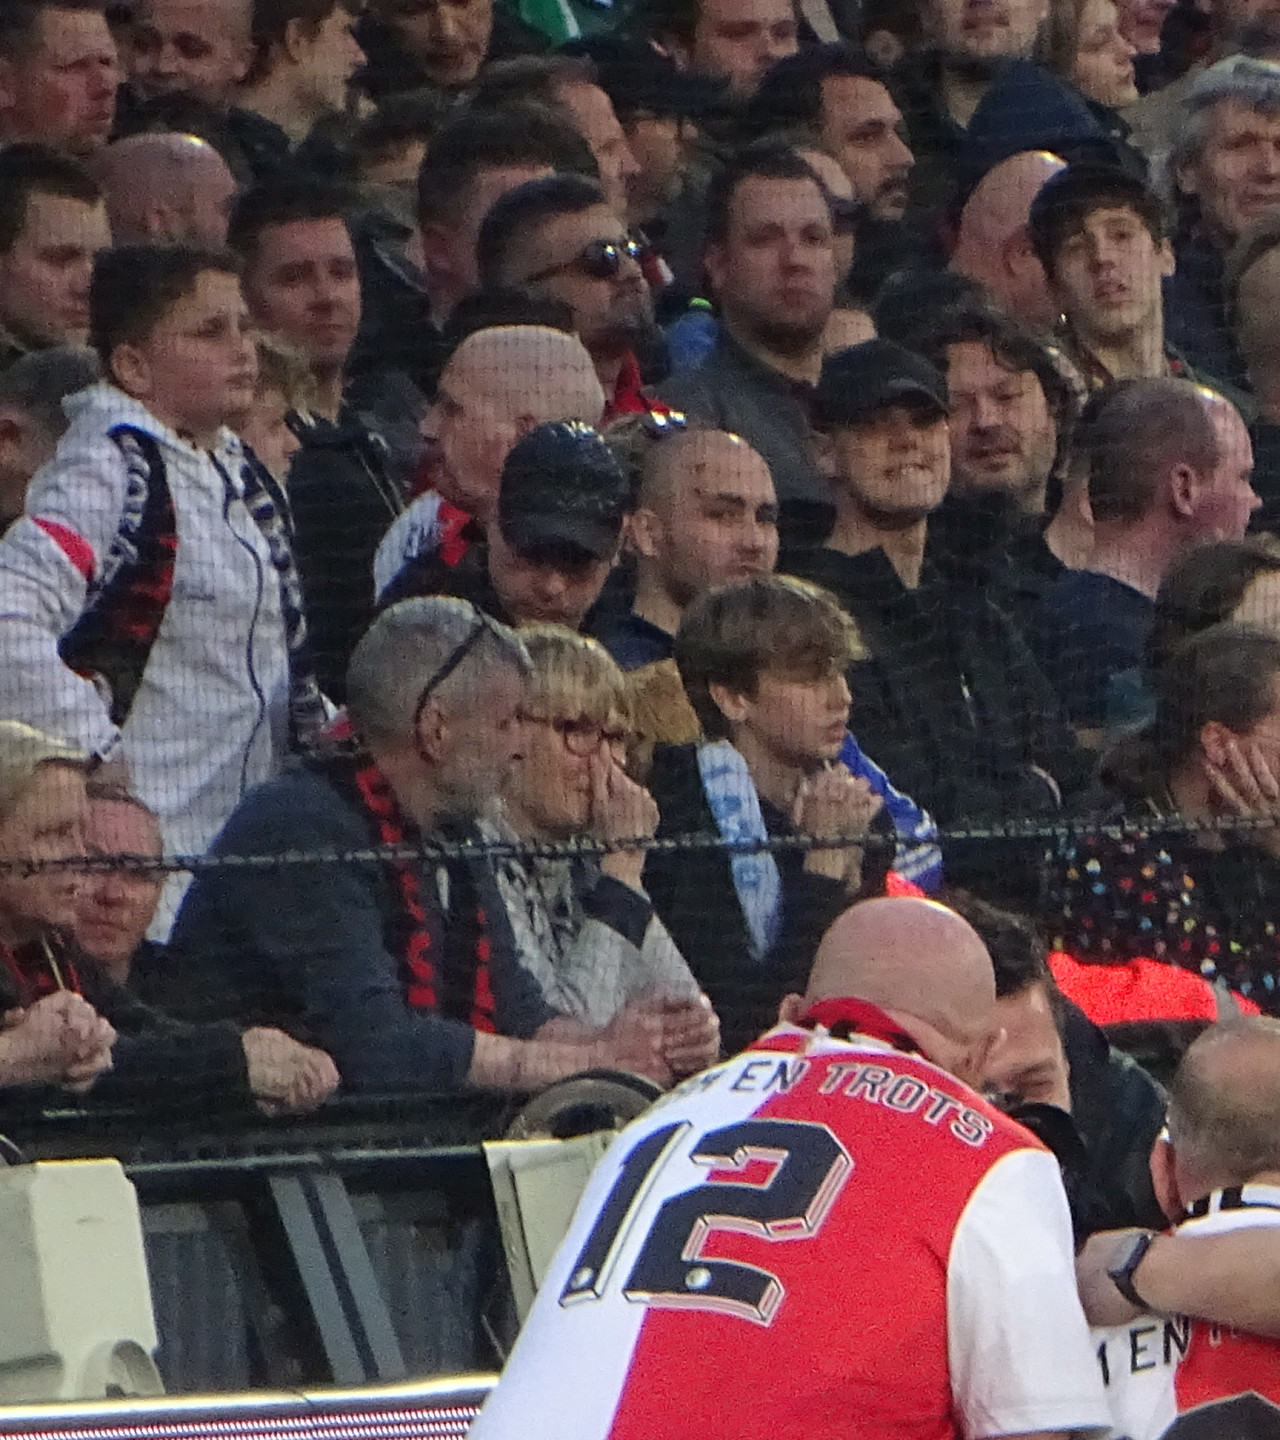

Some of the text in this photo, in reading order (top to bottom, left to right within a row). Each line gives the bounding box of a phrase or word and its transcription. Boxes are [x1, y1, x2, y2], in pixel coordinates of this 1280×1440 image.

[731, 1060, 811, 1094] EN
[819, 1061, 994, 1147] TROTS
[559, 1119, 853, 1327] 12
[1129, 1312, 1192, 1375] EN
